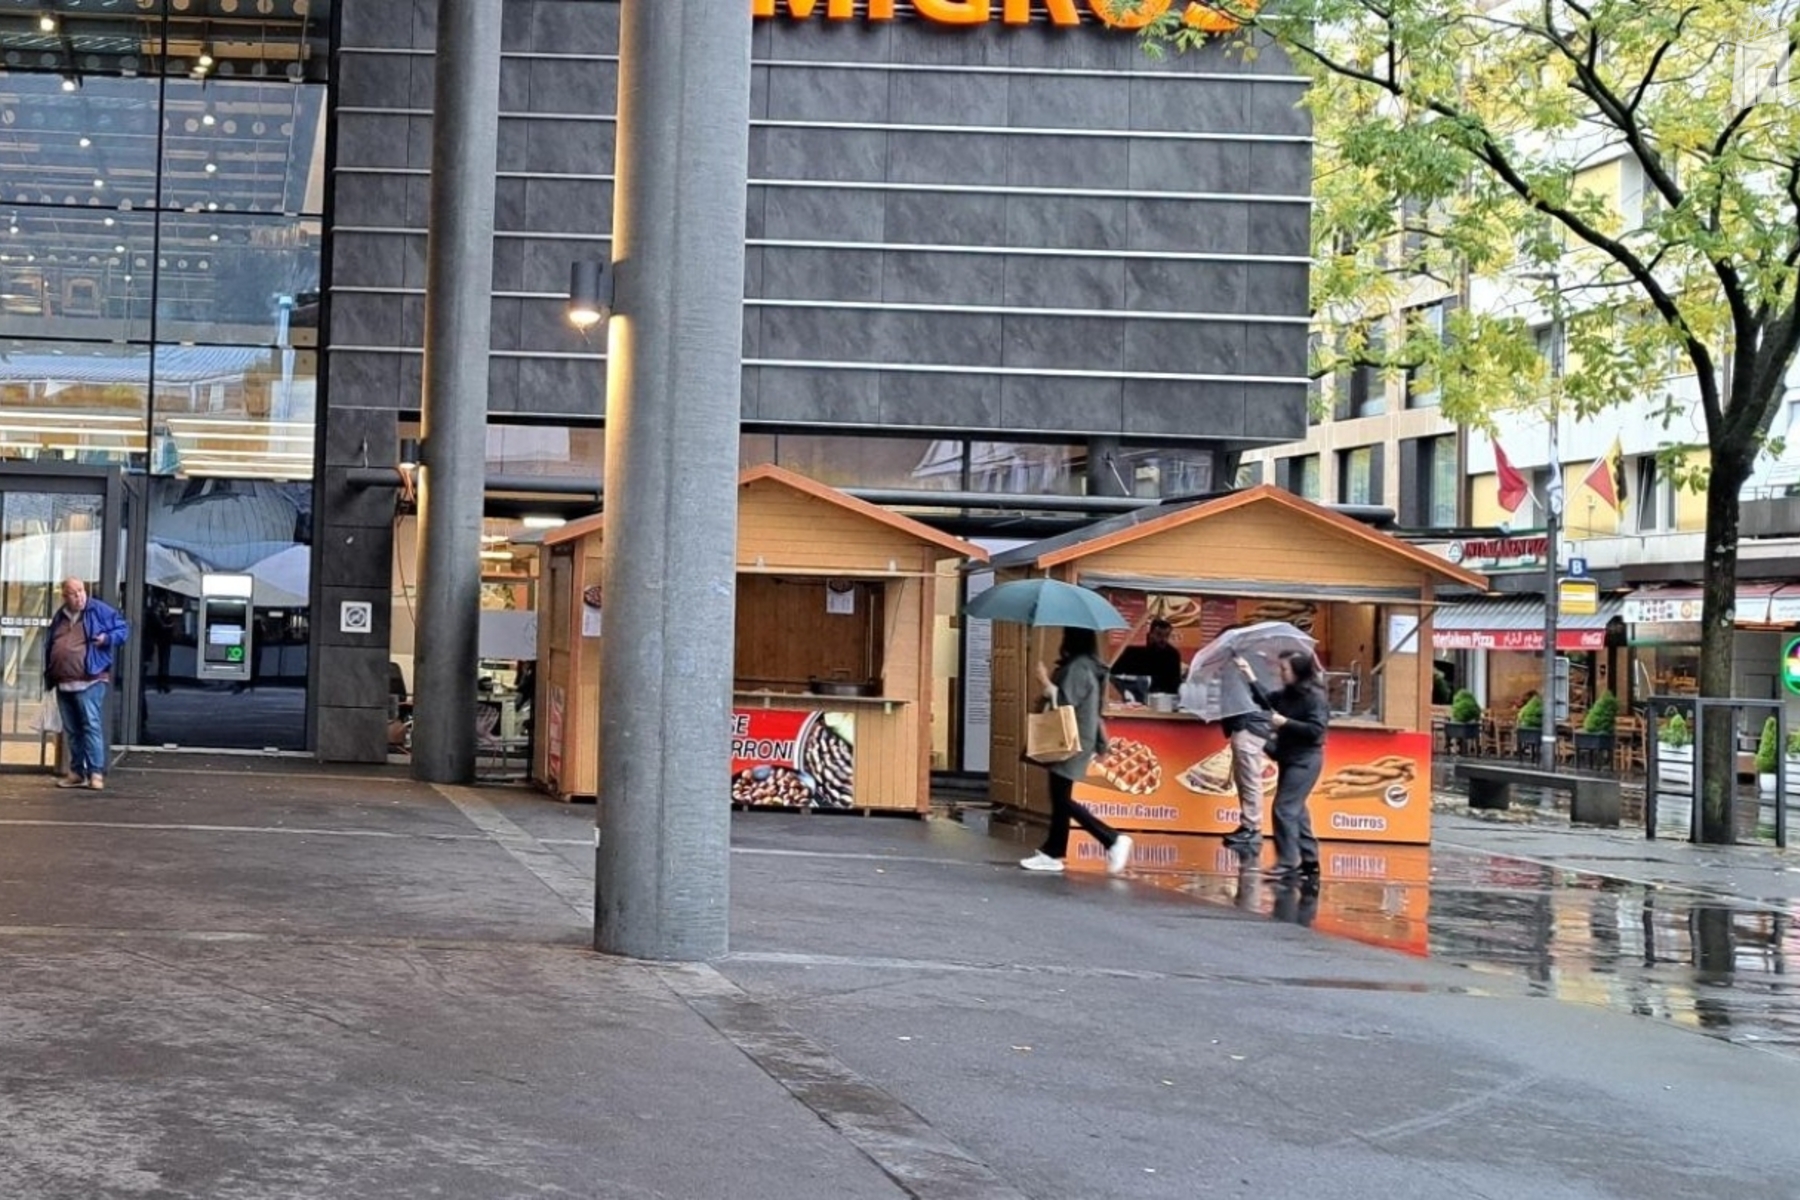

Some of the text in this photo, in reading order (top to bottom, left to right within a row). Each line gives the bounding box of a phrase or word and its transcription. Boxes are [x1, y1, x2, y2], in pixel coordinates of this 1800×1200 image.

[1572, 559, 1583, 575] B
[1472, 630, 1495, 648] Pizza
[1332, 813, 1385, 829] Churros
